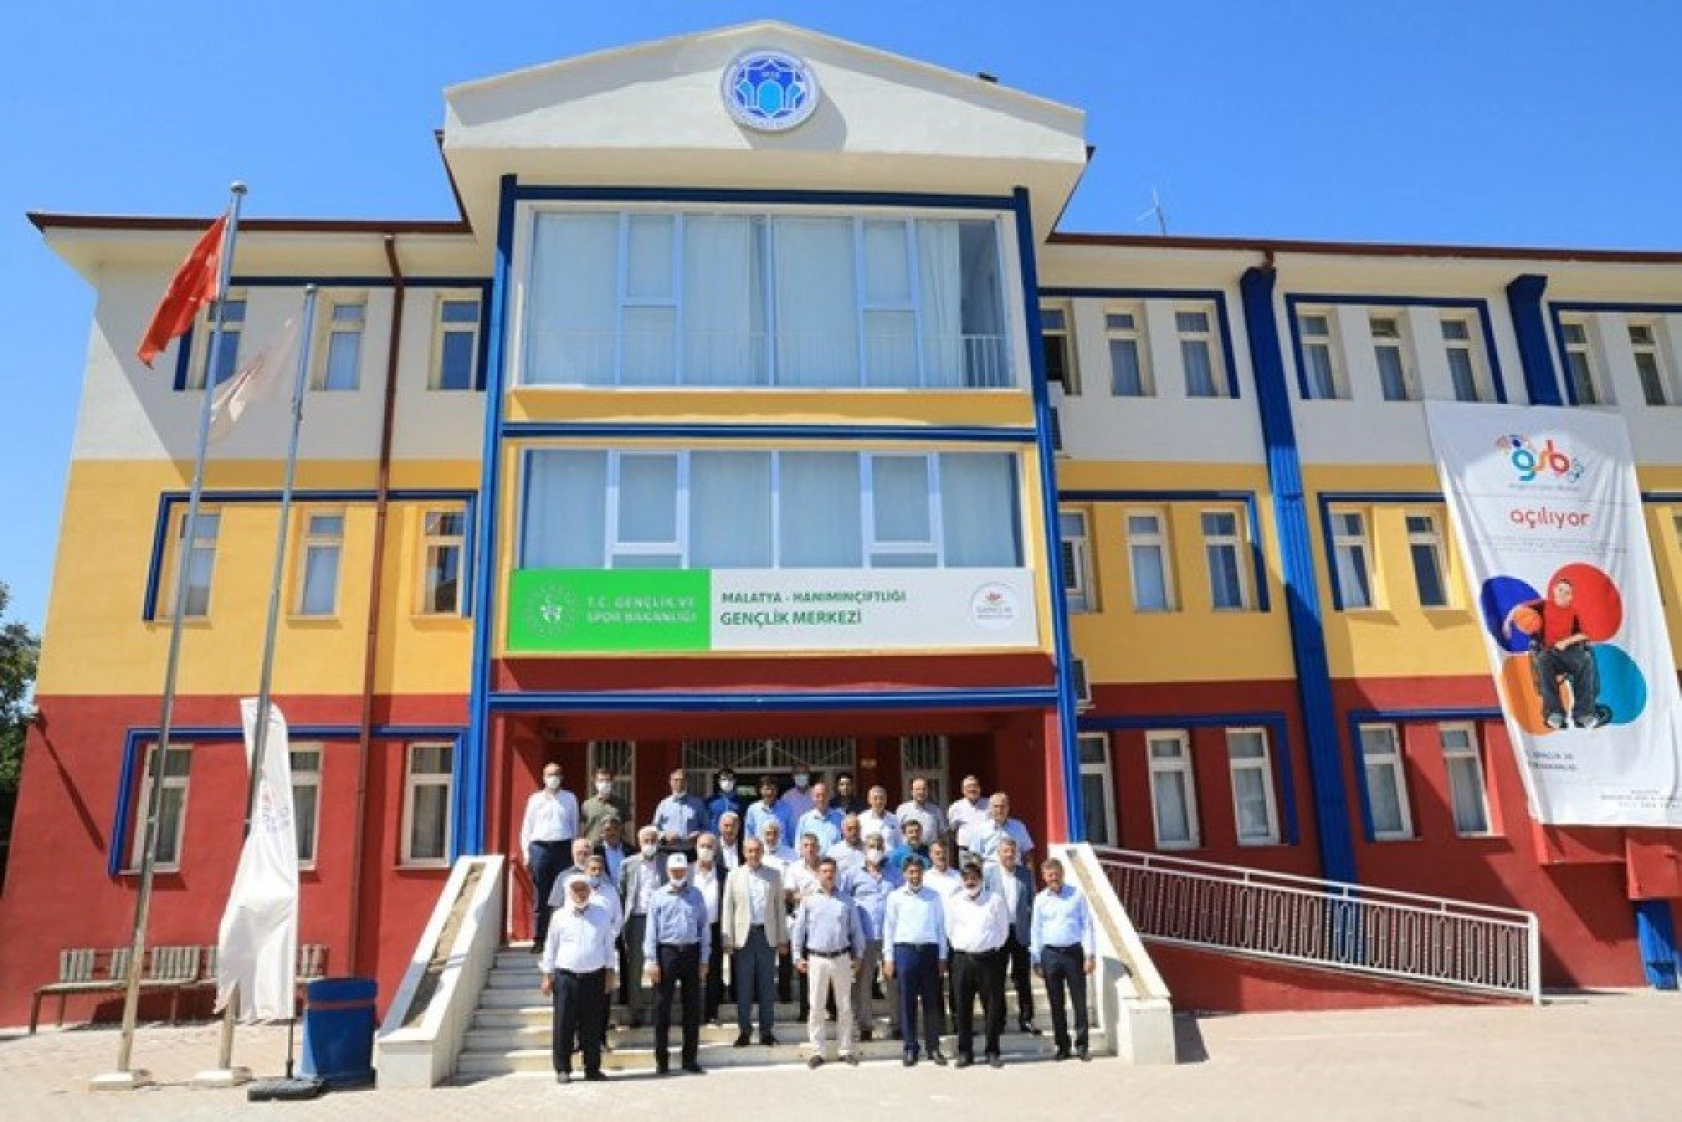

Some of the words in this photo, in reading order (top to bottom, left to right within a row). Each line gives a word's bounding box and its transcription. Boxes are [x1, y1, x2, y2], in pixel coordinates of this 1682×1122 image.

[1509, 506, 1590, 528] açılıyor
[721, 591, 782, 603] MALATYA
[720, 608, 789, 627] GENÇLİK
[792, 608, 862, 625] MERKEZİ
